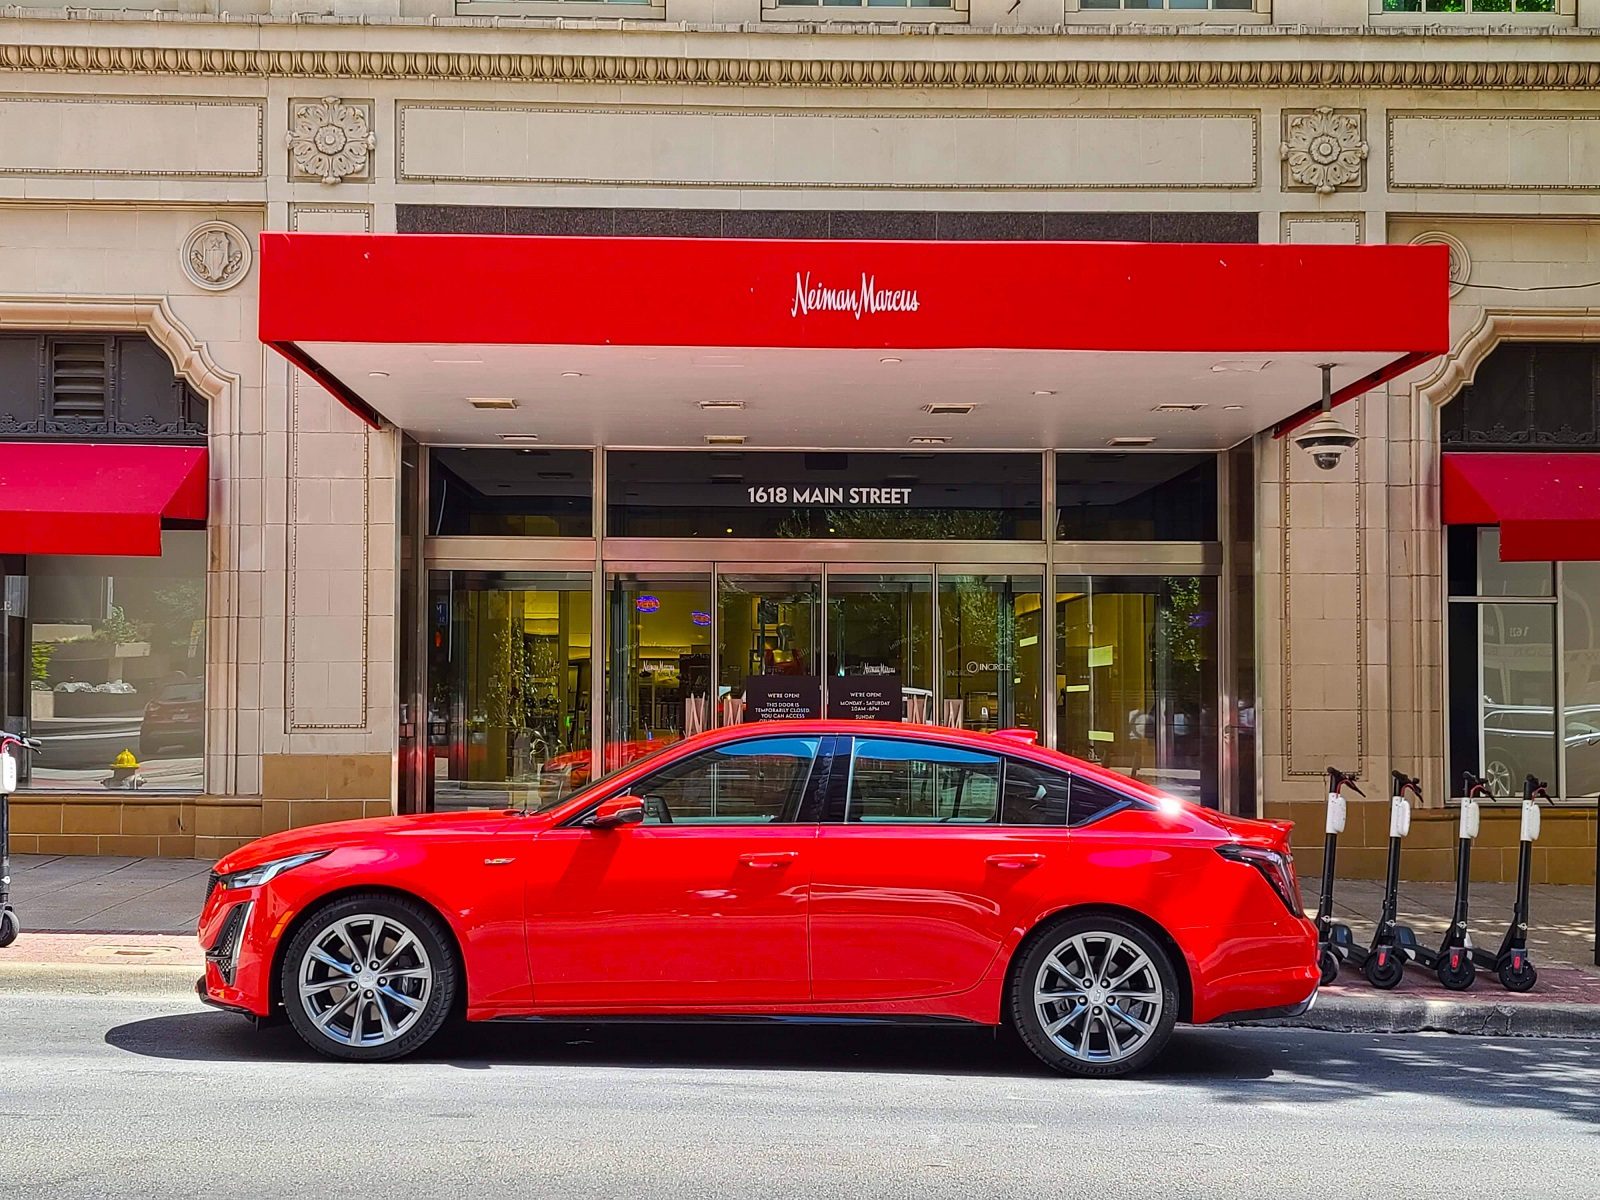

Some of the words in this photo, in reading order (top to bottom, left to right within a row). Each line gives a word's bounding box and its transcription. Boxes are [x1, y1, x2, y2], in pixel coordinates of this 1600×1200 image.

[791, 271, 858, 317] Neiman
[855, 272, 920, 320] Marcus
[747, 486, 788, 503] 1618
[793, 487, 844, 503] MAIN
[849, 487, 912, 504] STREET
